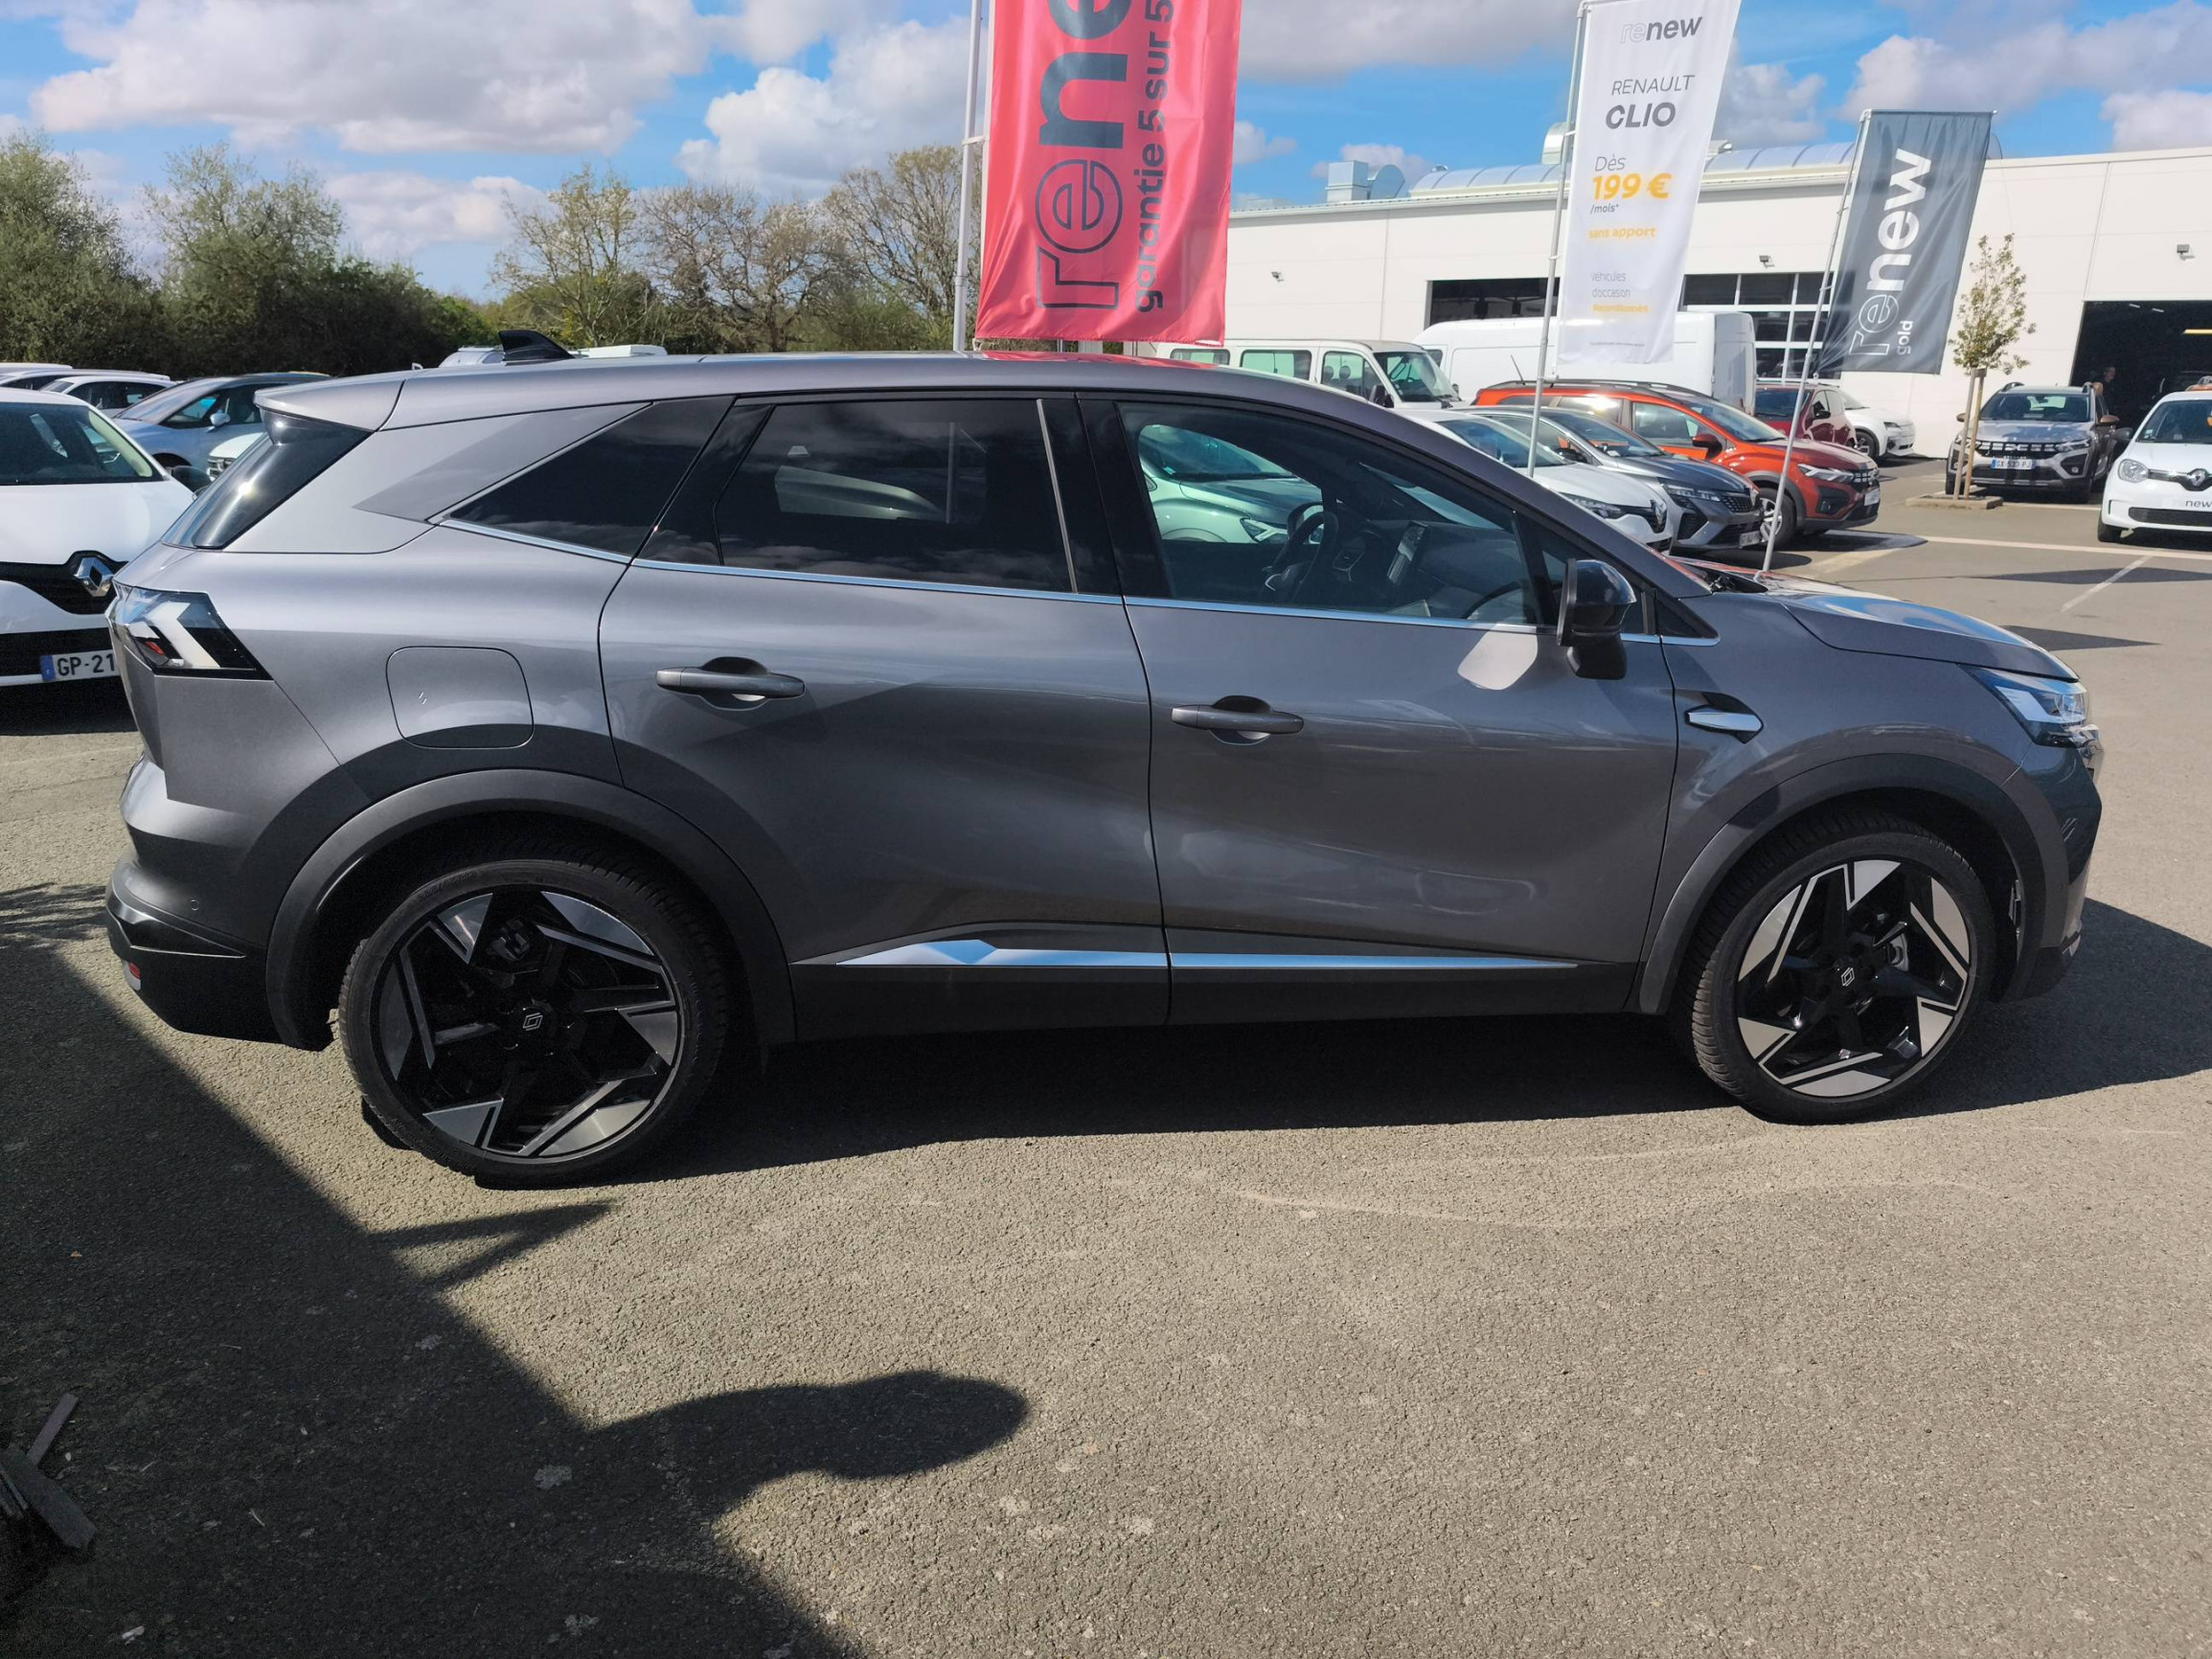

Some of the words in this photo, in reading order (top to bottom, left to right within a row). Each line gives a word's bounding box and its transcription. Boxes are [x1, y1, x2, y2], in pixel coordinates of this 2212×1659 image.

[1145, 0, 1174, 23] 5
[1146, 31, 1171, 101] sur
[1611, 75, 1695, 96] RENAULT
[1138, 109, 1164, 132] 5
[1606, 102, 1676, 129] CLIO
[1594, 154, 1627, 171] Dès
[1592, 173, 1641, 200] 199
[1647, 172, 1673, 199] €
[1133, 143, 1165, 314] garantie
[1612, 228, 1656, 239] apport
[1849, 148, 1931, 356] renew
[1897, 320, 1914, 355] gold
